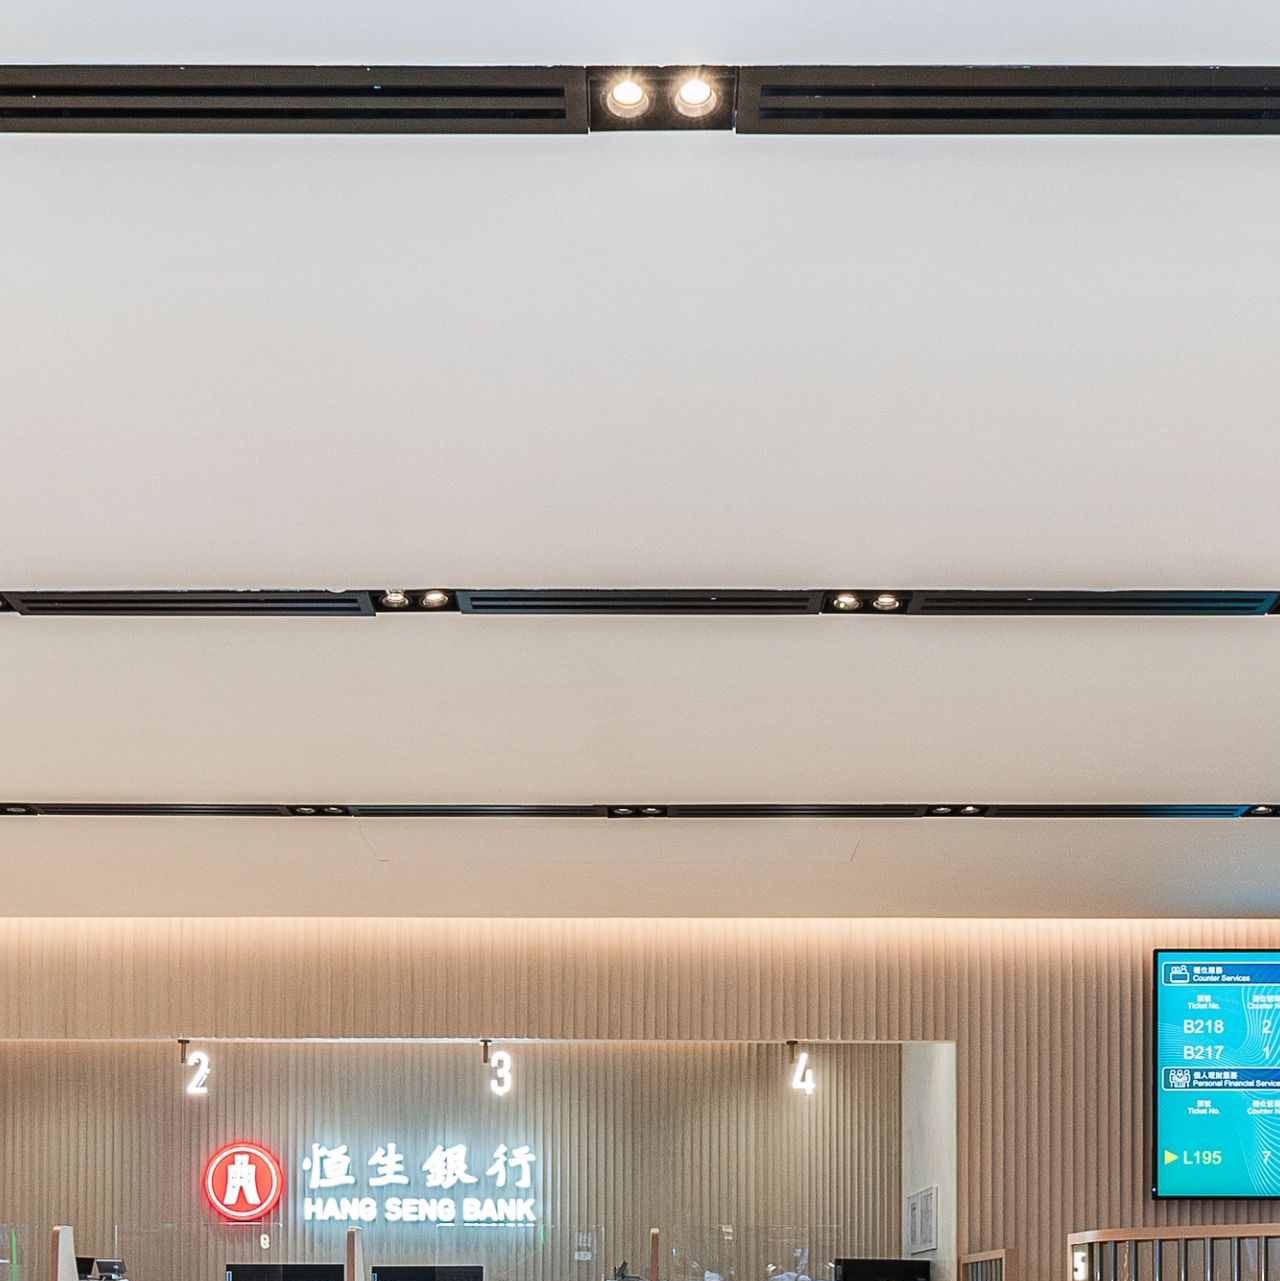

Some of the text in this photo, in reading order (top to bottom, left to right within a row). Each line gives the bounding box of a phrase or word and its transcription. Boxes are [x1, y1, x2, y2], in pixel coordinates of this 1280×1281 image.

[1247, 1002, 1273, 1010] Counter
[1183, 1019, 1224, 1034] B218
[1262, 1019, 1273, 1034] 2
[1183, 1045, 1224, 1060] B217
[1263, 1045, 1271, 1060] 1
[186, 1051, 211, 1093] 2
[490, 1051, 512, 1096] 3
[792, 1052, 816, 1096] 4
[1193, 1080, 1223, 1088] Personal
[1183, 1150, 1223, 1165] L195
[1262, 1150, 1272, 1164] 7
[302, 1142, 536, 1189] 恒生銀行
[304, 1197, 536, 1221] HANG SENG BANK
